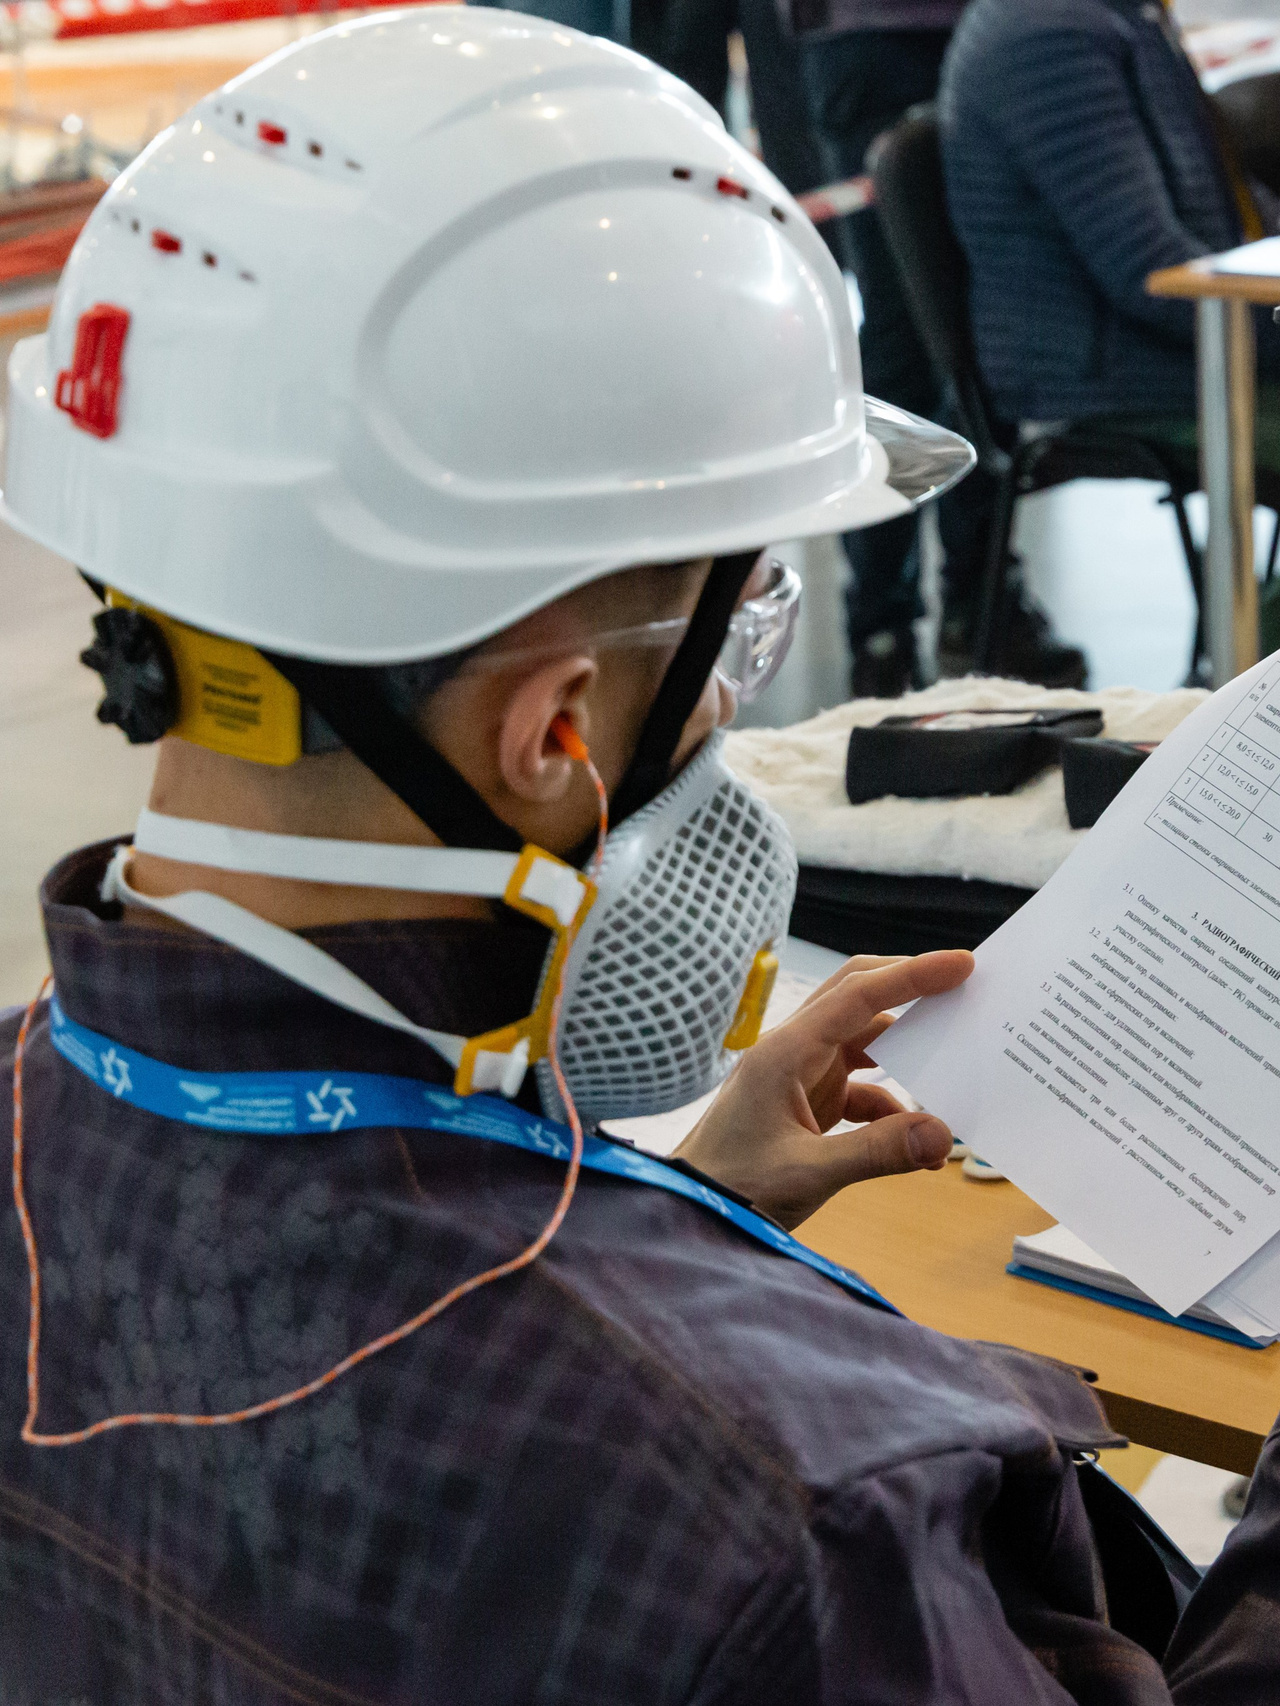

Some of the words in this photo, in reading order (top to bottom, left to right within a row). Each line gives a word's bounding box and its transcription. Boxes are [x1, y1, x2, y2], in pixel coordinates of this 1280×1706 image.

[1198, 787, 1213, 800] 15,0
[1224, 805, 1241, 820] 20,0
[1216, 763, 1231, 776] 12,0
[1243, 782, 1259, 795] 15,0
[1161, 818, 1189, 840] толщина
[1188, 838, 1211, 856] стенки
[1210, 854, 1250, 884] свариваемых
[1262, 832, 1272, 842] 30
[1112, 924, 1138, 944] участку
[1136, 941, 1164, 966] отдельно.
[1123, 909, 1181, 953] радиографического
[1179, 950, 1208, 974] контроля
[1206, 970, 1228, 988] (далее
[1244, 999, 1274, 1023] проводят
[1137, 893, 1160, 915] Оценку
[1161, 913, 1188, 935] качества
[1189, 934, 1215, 956] сварных
[1218, 955, 1255, 984] соединений
[1054, 972, 1074, 988] длина
[1078, 989, 1102, 1010] ширина
[1113, 1018, 1151, 1049] удлиненных
[1167, 1059, 1203, 1090] включений.
[1067, 959, 1093, 980] диаметр
[1106, 988, 1143, 1019] сферических
[1158, 1029, 1195, 1059] включений;
[1090, 952, 1130, 983] изображений
[1133, 986, 1178, 1023] радиограммах:
[1108, 944, 1136, 965] размеры
[1134, 963, 1147, 976] пор,
[1148, 973, 1178, 999] шлаковых
[1183, 1000, 1228, 1036] вольфрамовых
[1227, 1034, 1264, 1063] включений
[1039, 1029, 1074, 1058] включений
[1076, 1059, 1108, 1088] скоплении.
[1040, 1007, 1060, 1025] длина,
[1060, 1023, 1094, 1051] измеренная
[1102, 1056, 1130, 1080] наиболее
[1128, 1077, 1164, 1106] удаленным
[1161, 1104, 1178, 1117] друг
[1184, 1122, 1204, 1138] друга
[1202, 1136, 1223, 1153] краям
[1221, 1151, 1264, 1185] изображений
[1058, 999, 1082, 1018] размер
[1080, 1015, 1111, 1041] скопления
[1109, 1038, 1122, 1051] пор,
[1121, 1048, 1153, 1074] шлаковых
[1162, 1080, 1207, 1117] вольфрамовых
[1205, 1113, 1241, 1142] включений
[1238, 1139, 1279, 1173] принимается
[1003, 1047, 1033, 1074] шлаковых
[1046, 1083, 1089, 1119] вольфрамовых
[1088, 1117, 1122, 1145] включений
[1125, 1148, 1165, 1180] расстоянием
[1164, 1179, 1185, 1198] между
[1185, 1196, 1213, 1219] любыми
[1212, 1218, 1234, 1235] двумя
[1016, 1033, 1052, 1065] Скоплением
[1053, 1065, 1087, 1093] называется
[1118, 1116, 1137, 1133] более
[1136, 1133, 1185, 1172] расположенных
[1188, 1172, 1230, 1208] беспорядочно
[1232, 1209, 1246, 1223] пор,
